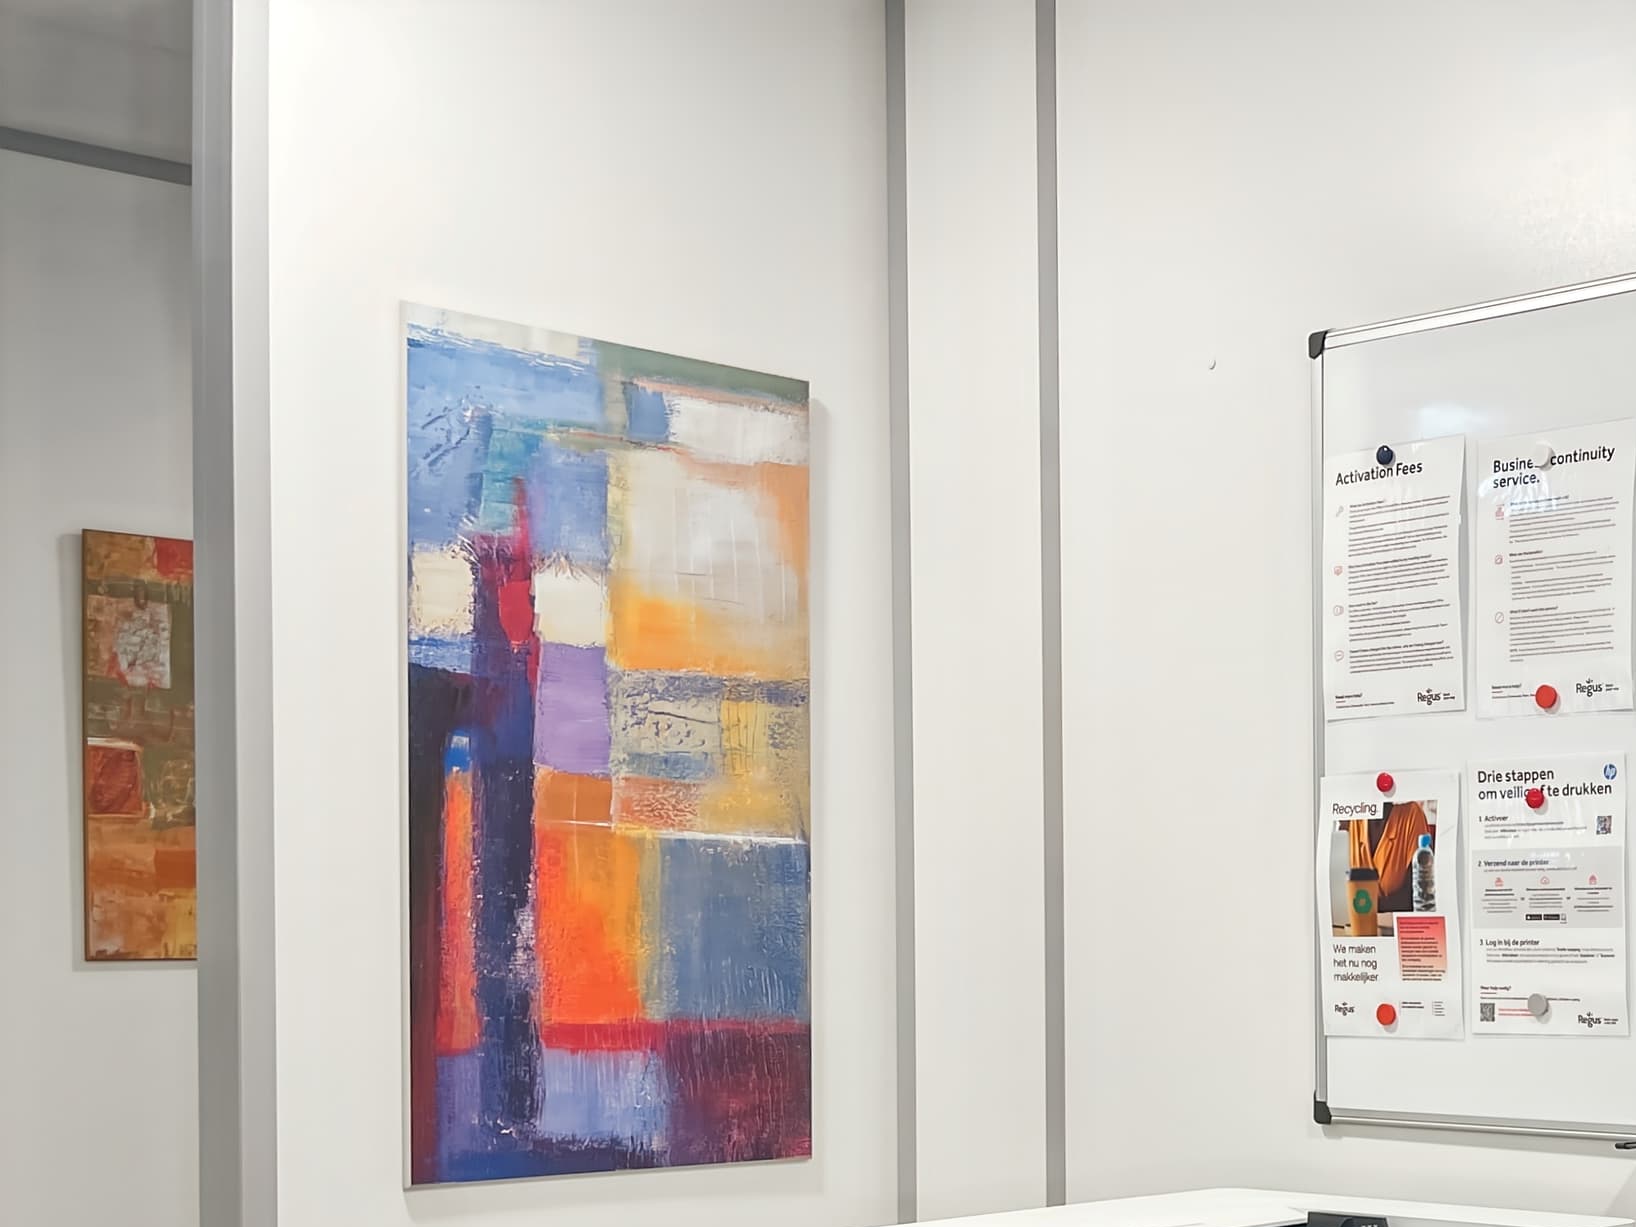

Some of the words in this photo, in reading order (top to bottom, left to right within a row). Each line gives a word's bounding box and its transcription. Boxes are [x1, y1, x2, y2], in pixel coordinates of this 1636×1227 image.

[1494, 458, 1542, 473] Busine
[1550, 446, 1615, 466] continuity
[1336, 466, 1393, 485] Activation
[1396, 462, 1422, 476] Fees
[1494, 472, 1540, 488] service.
[1576, 682, 1602, 697] Regus
[1418, 692, 1441, 705] Regus
[1478, 770, 1502, 783] Drie
[1506, 770, 1554, 784] stappen
[1478, 790, 1497, 800] om
[1547, 786, 1559, 797] te
[1562, 782, 1612, 797] drukken
[1332, 802, 1377, 816] Recycling
[1333, 944, 1346, 953] We
[1349, 944, 1376, 953] maken
[1334, 959, 1347, 967] het
[1362, 960, 1377, 970] nog
[1334, 972, 1378, 983] makkelijker
[1335, 1004, 1354, 1016] Regus
[1578, 1014, 1602, 1028] Regus
